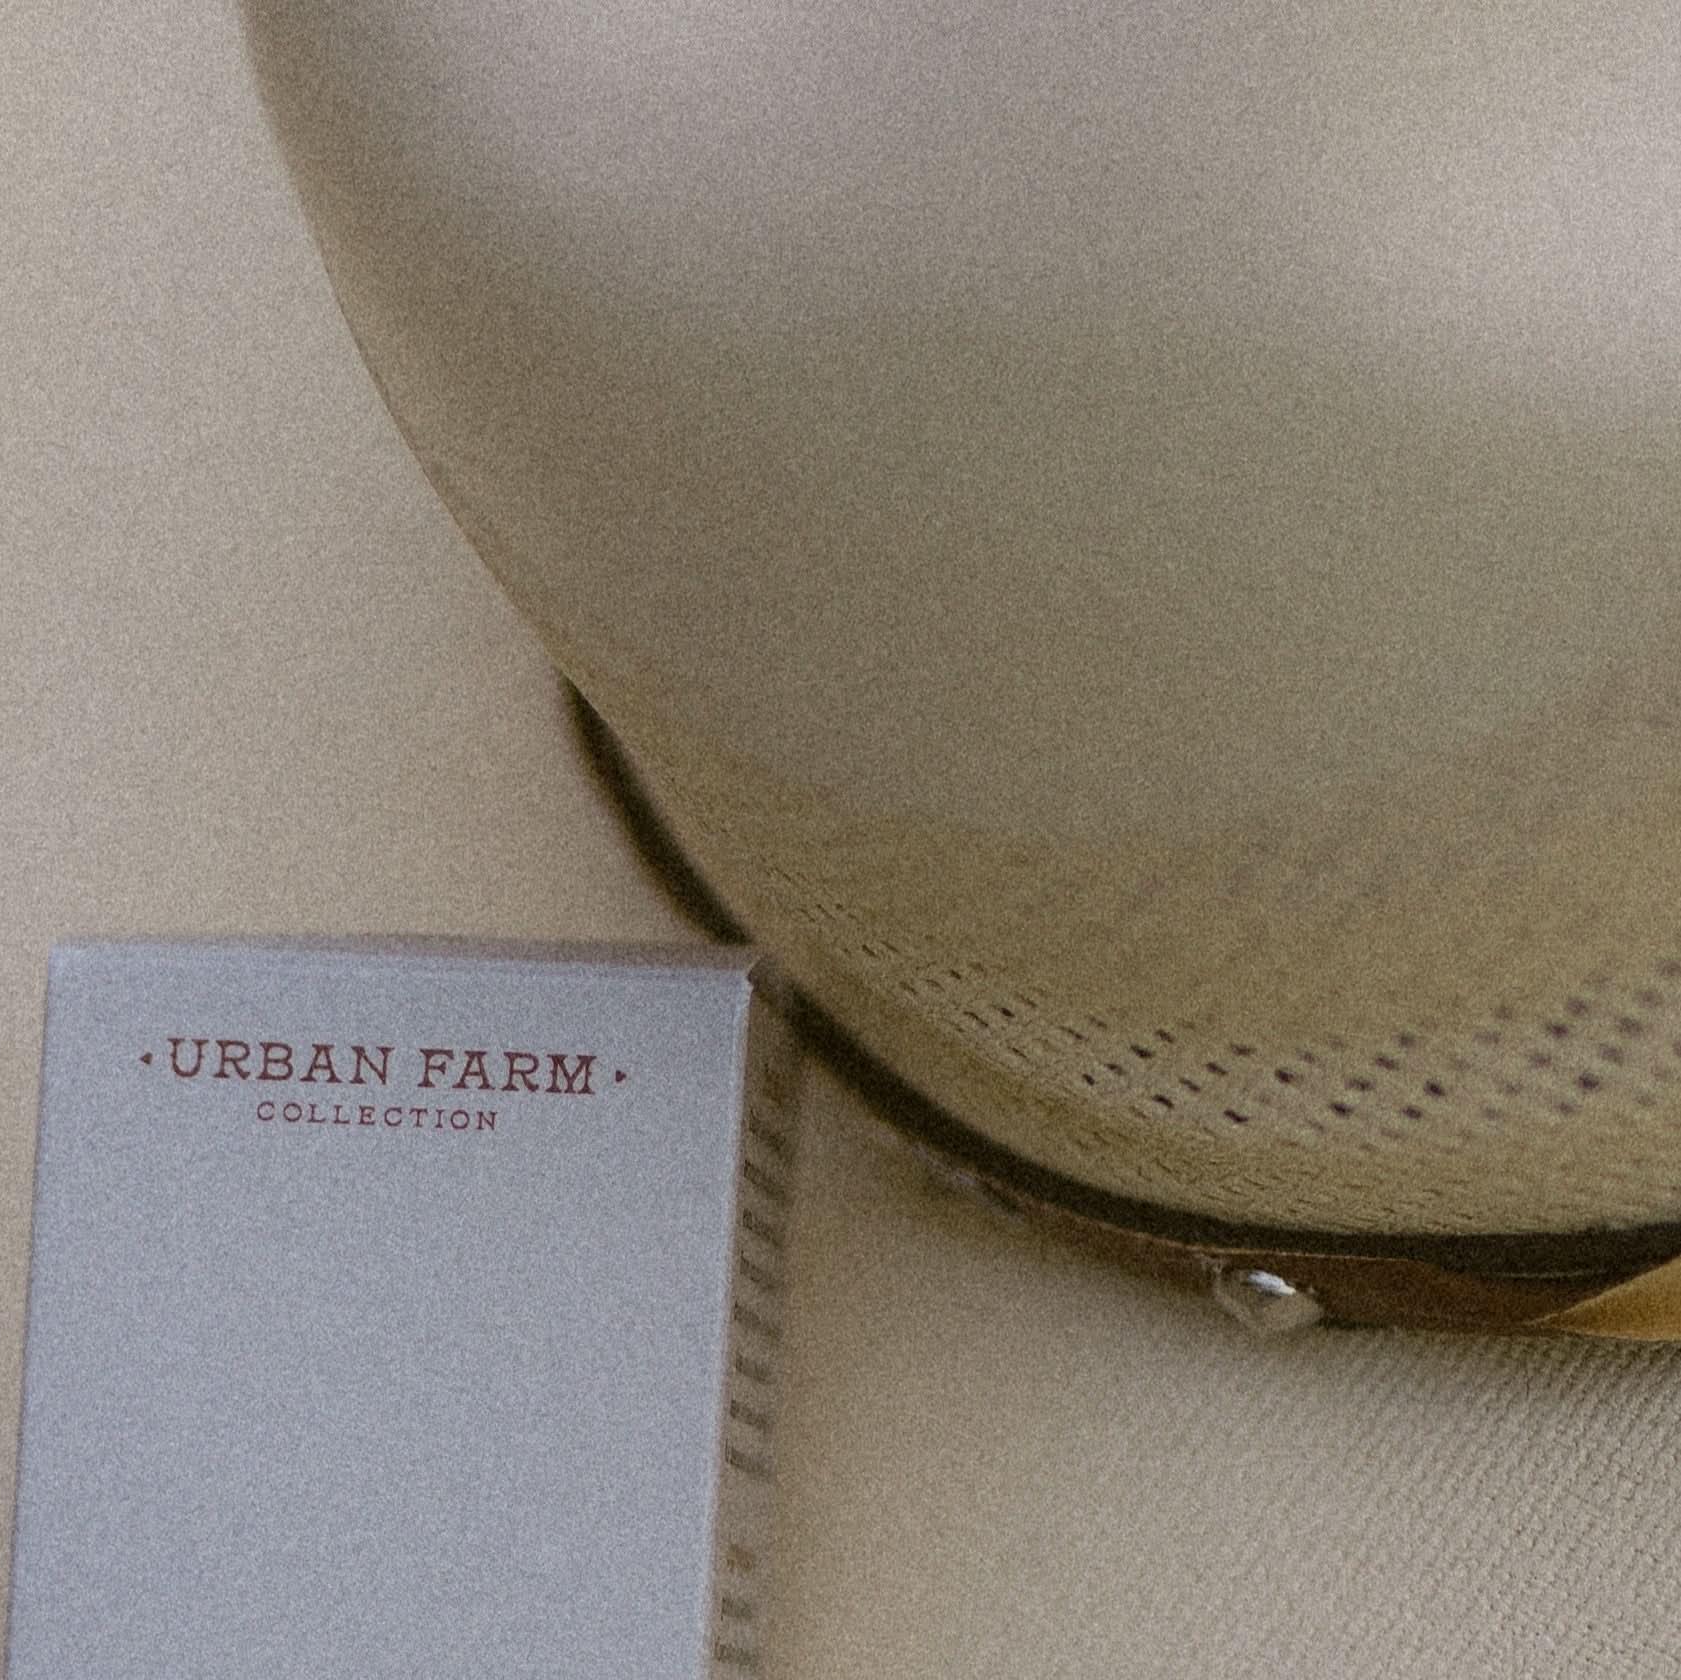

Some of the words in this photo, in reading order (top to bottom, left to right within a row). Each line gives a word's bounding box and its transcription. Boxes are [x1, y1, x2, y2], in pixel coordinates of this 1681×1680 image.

[168, 1038, 395, 1085] URBAN
[417, 1047, 597, 1095] FARM
[256, 1101, 498, 1130] COLLECTION
